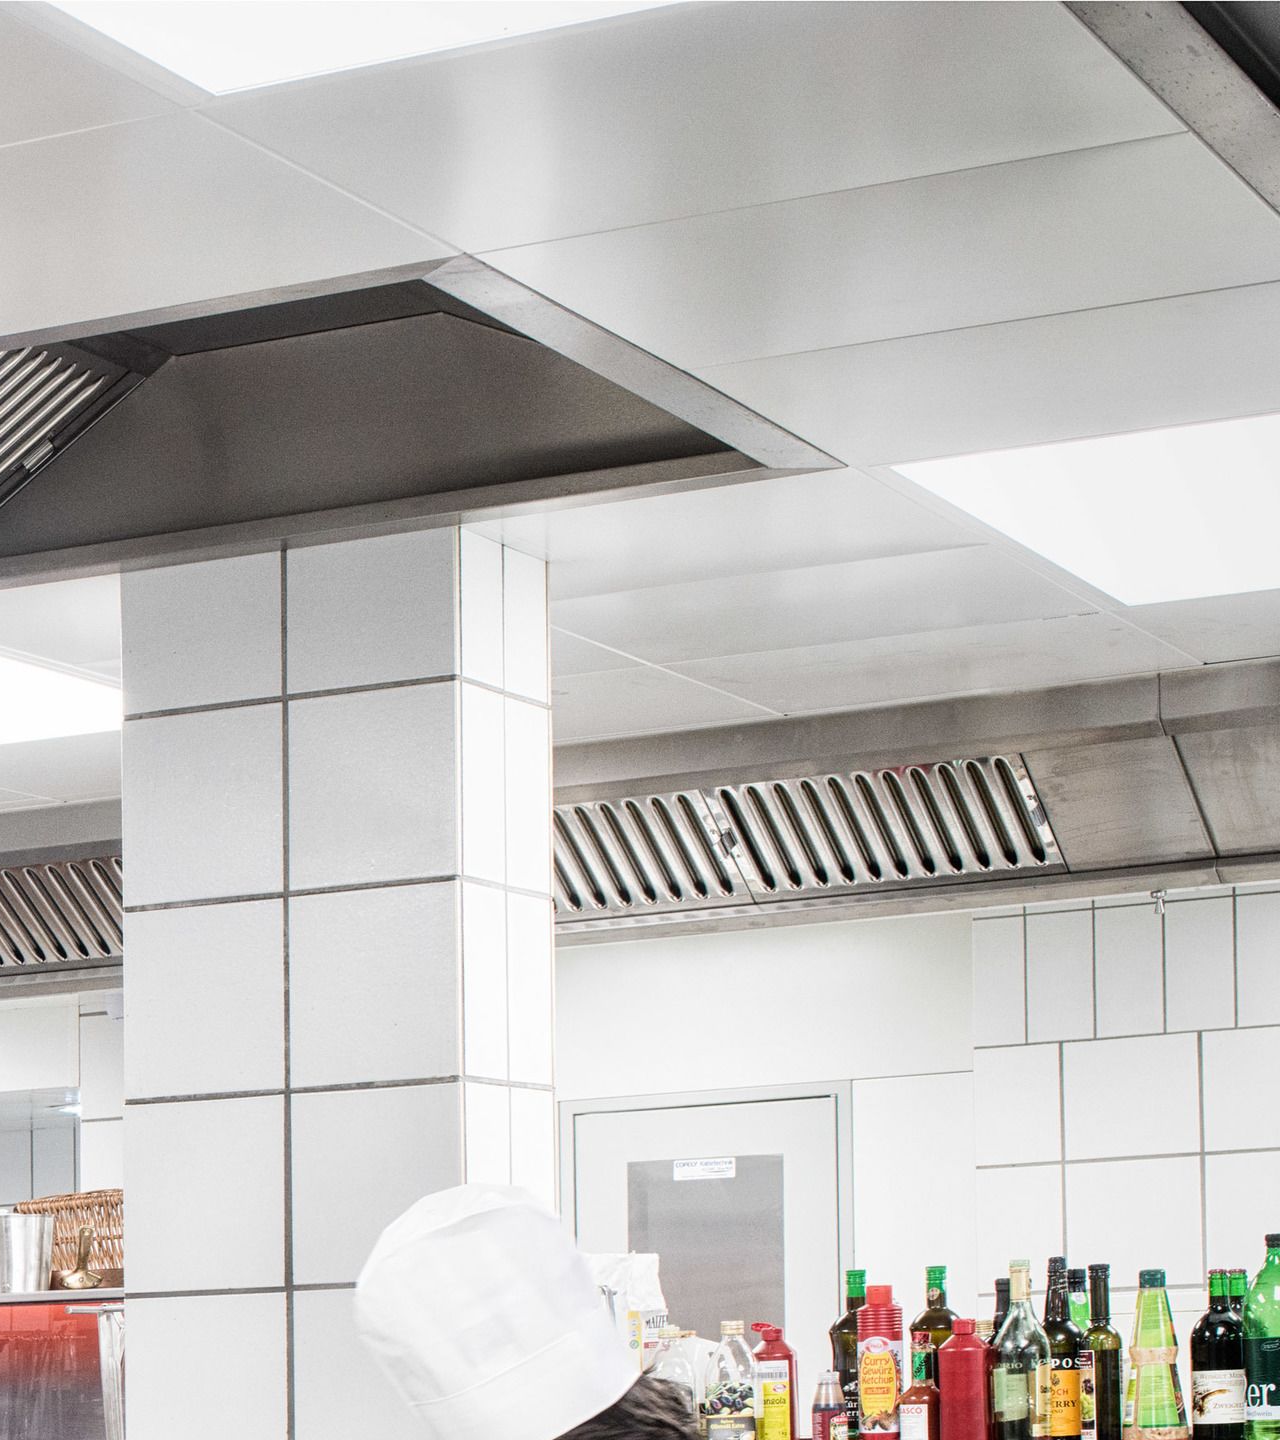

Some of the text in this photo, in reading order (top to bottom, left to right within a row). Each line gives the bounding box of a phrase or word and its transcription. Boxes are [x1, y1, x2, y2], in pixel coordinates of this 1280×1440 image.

[864, 1357, 890, 1366] Curry
[863, 1367, 893, 1375] Gewürz
[861, 1376, 894, 1384] Ketchup
